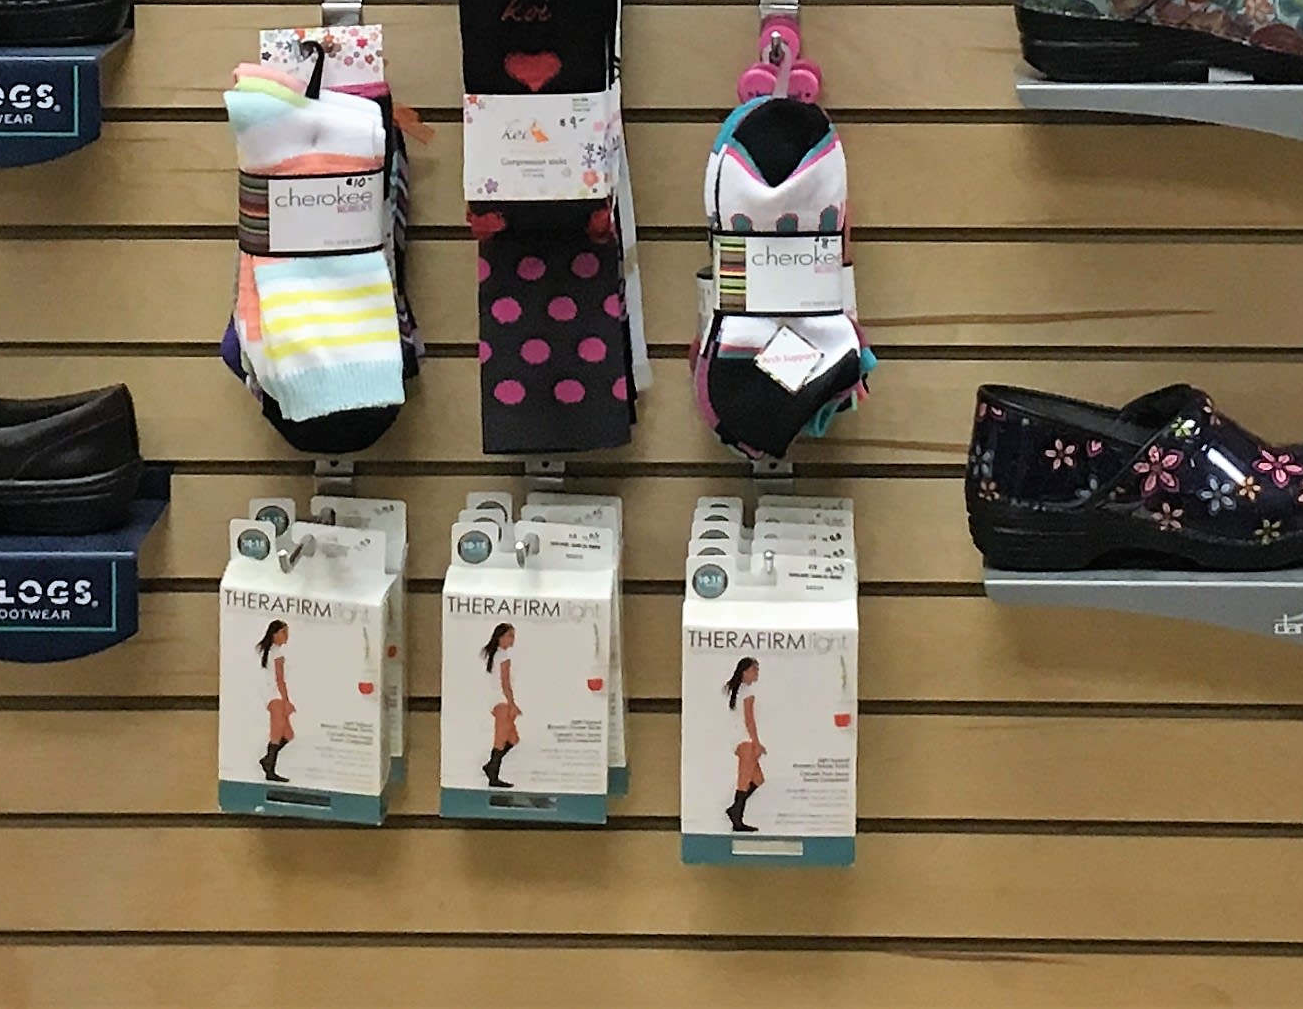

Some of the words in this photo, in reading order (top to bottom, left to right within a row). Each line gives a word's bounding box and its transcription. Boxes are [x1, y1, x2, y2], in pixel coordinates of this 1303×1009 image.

[275, 184, 373, 207] cherokee
[224, 589, 331, 618] THERAFIRM
[447, 595, 561, 617] THERAFIRM
[688, 630, 806, 650] THERAFIRM
